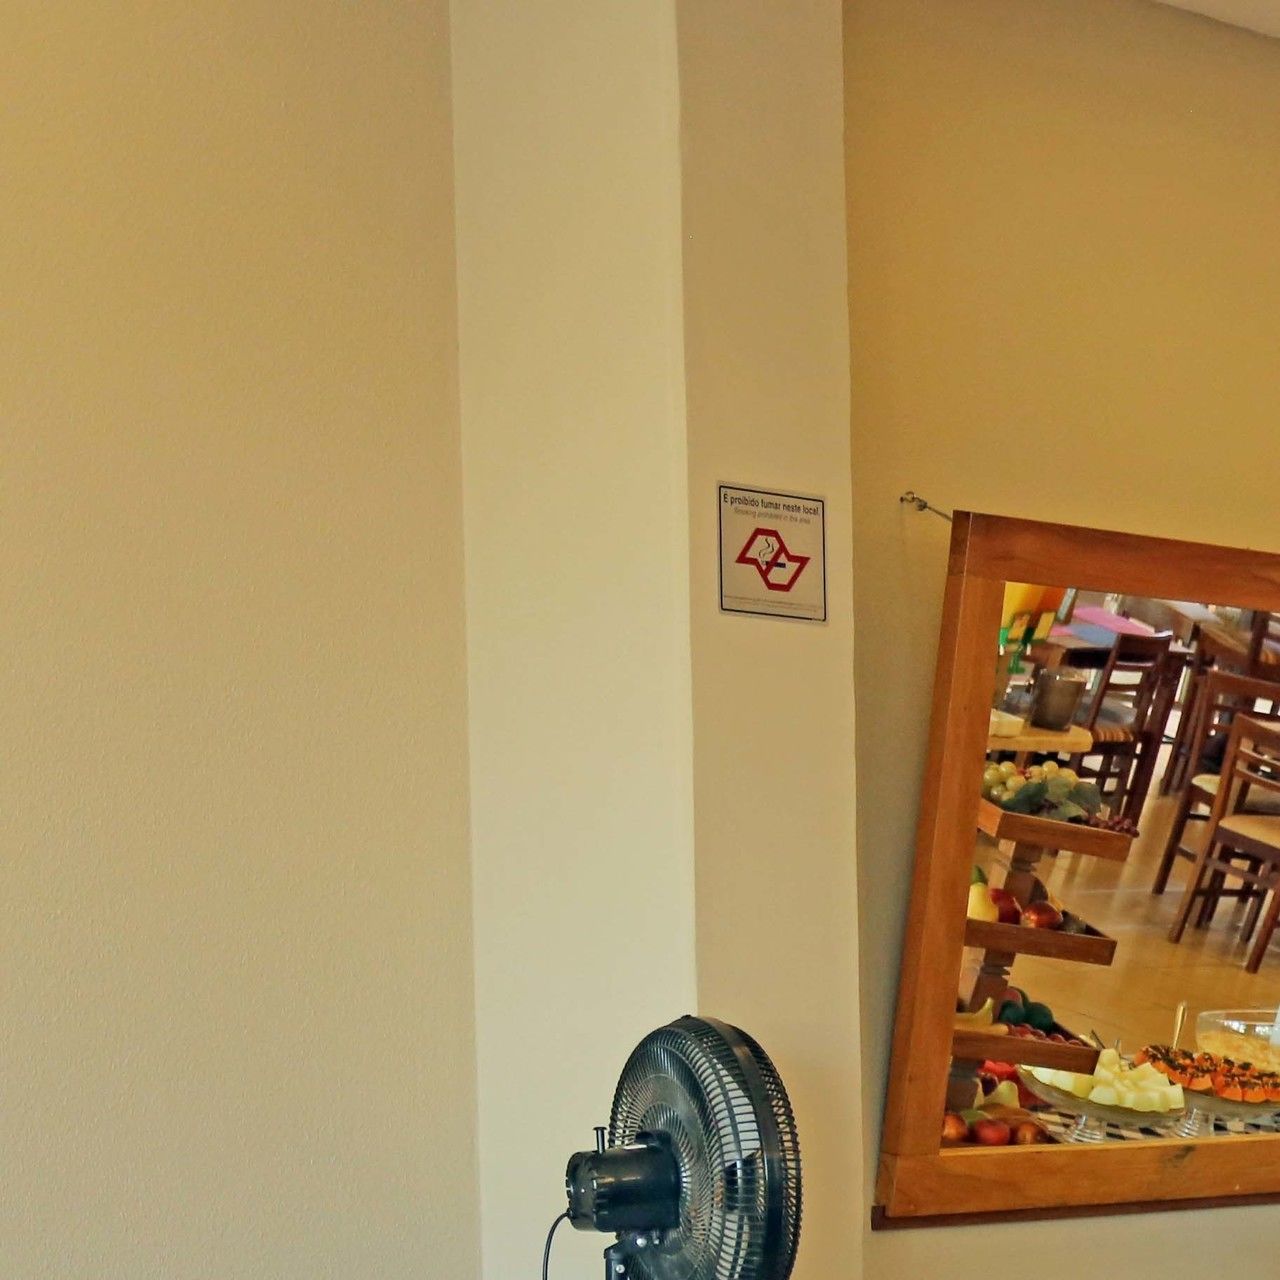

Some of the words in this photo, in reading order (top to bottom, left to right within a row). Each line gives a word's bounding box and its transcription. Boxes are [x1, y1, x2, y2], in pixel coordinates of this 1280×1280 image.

[730, 496, 759, 507] proibido
[761, 498, 781, 510] fumar
[782, 502, 800, 512] neste
[802, 504, 818, 516] local
